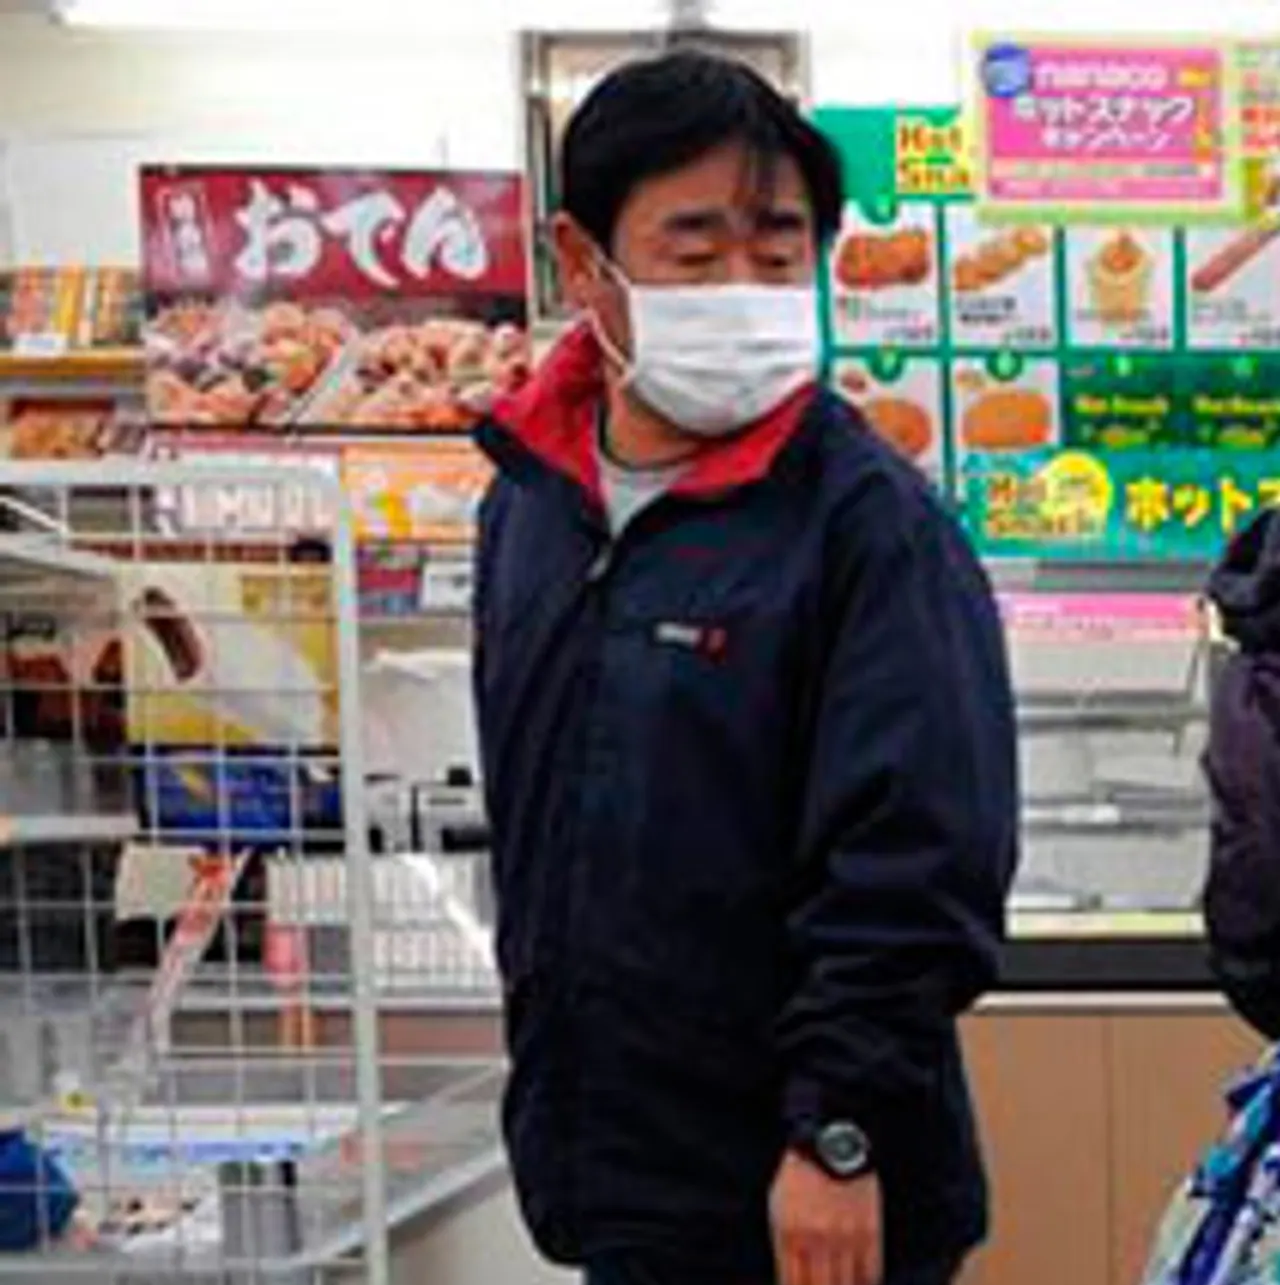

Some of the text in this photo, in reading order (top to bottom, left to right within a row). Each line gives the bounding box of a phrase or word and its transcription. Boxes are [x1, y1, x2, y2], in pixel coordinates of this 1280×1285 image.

[1016, 95, 1193, 127] ホットスナック
[232, 178, 487, 288] おでん
